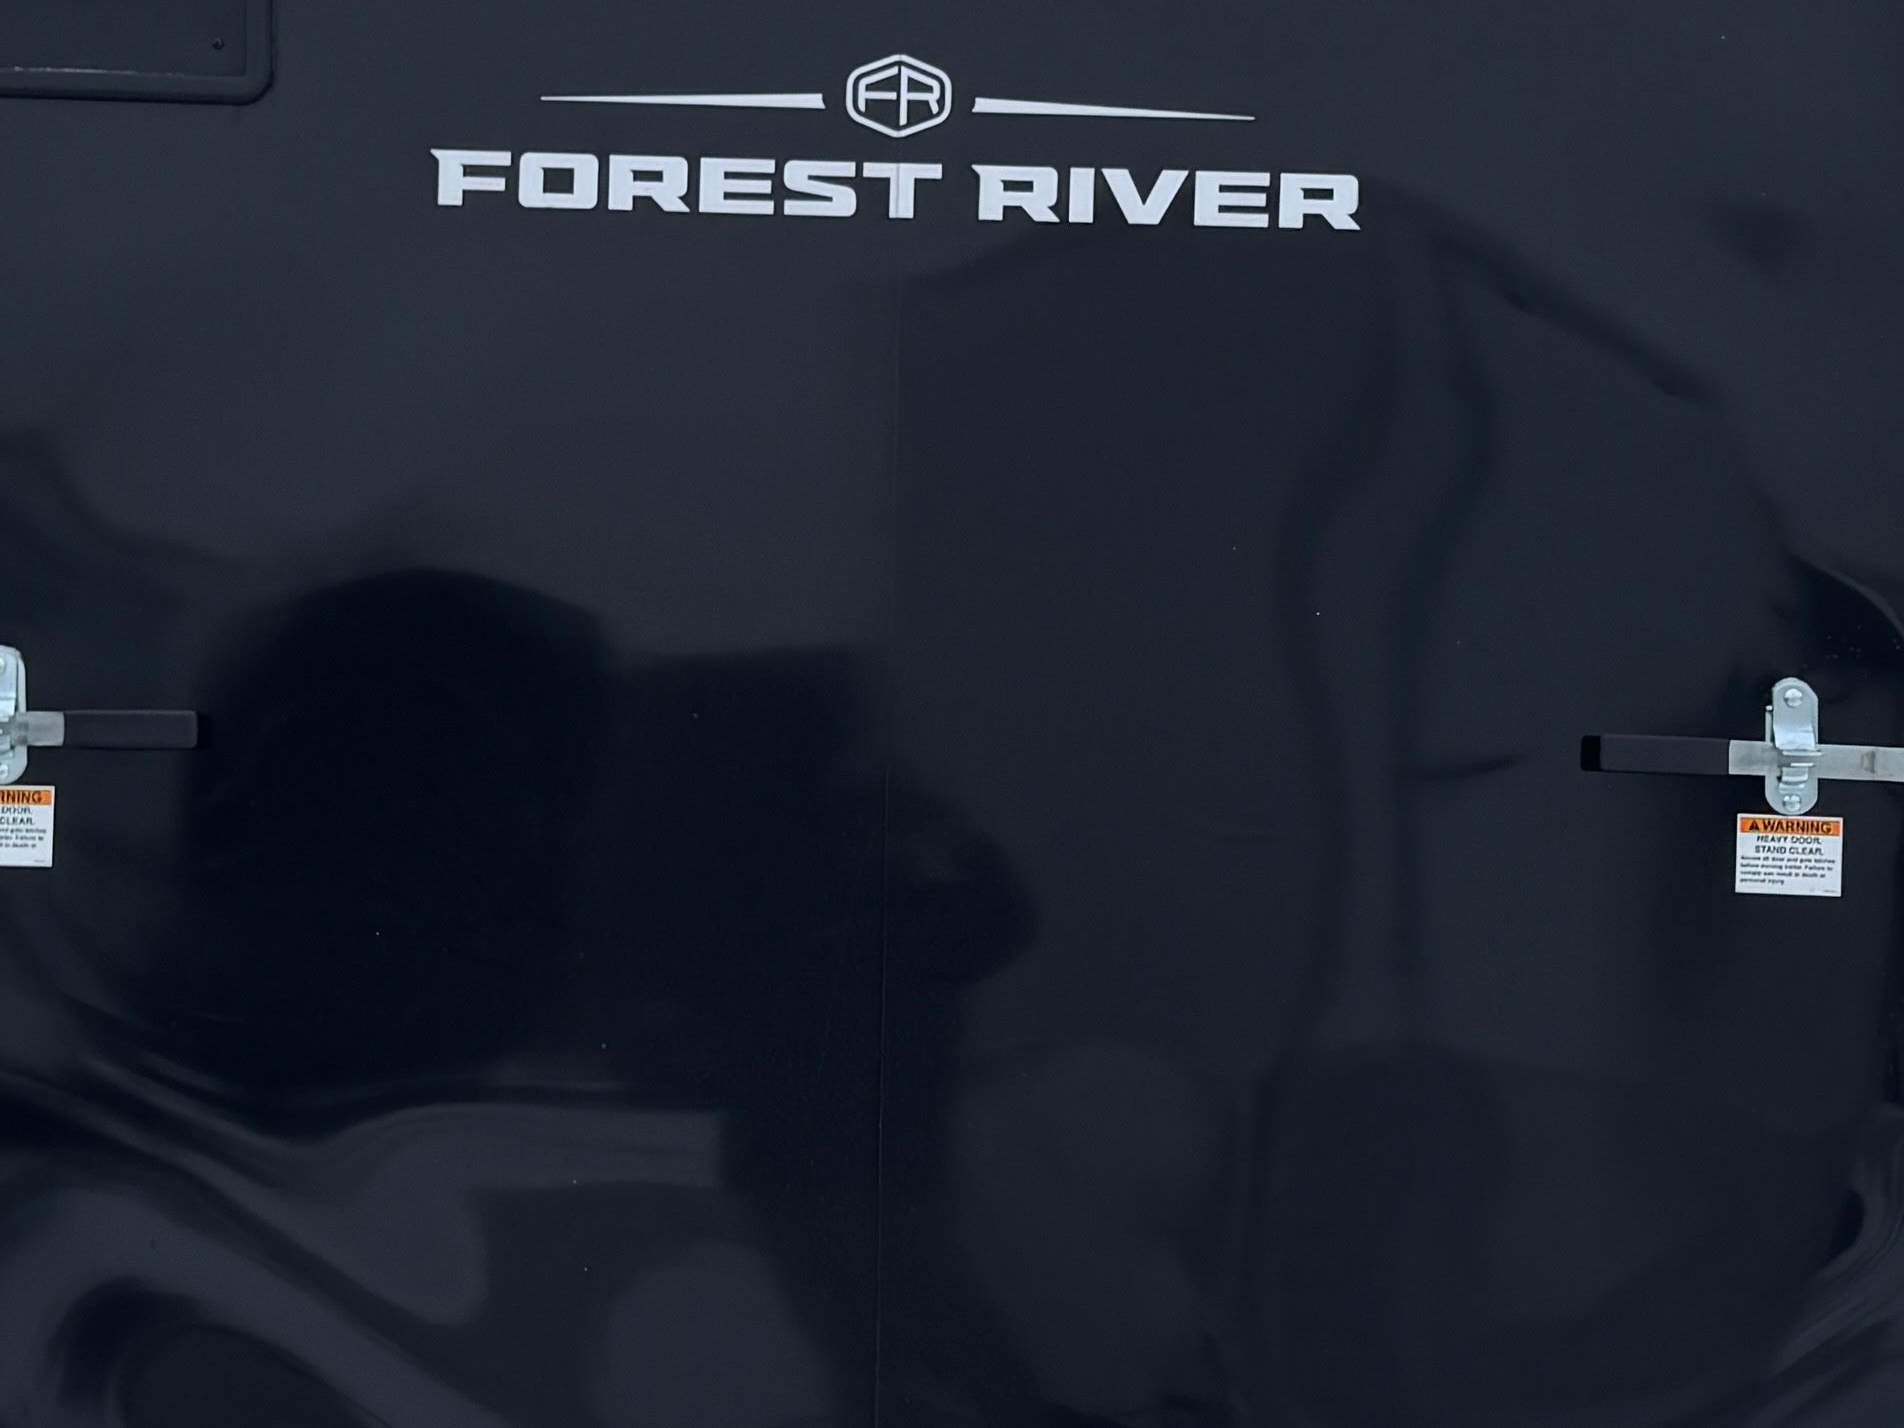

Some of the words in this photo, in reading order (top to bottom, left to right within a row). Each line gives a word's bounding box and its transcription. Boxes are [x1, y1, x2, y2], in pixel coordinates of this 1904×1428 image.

[429, 148, 943, 220] FOREST
[971, 163, 1362, 232] RIVER
[1762, 818, 1832, 835] WARNING
[1754, 845, 1787, 854] STAND
